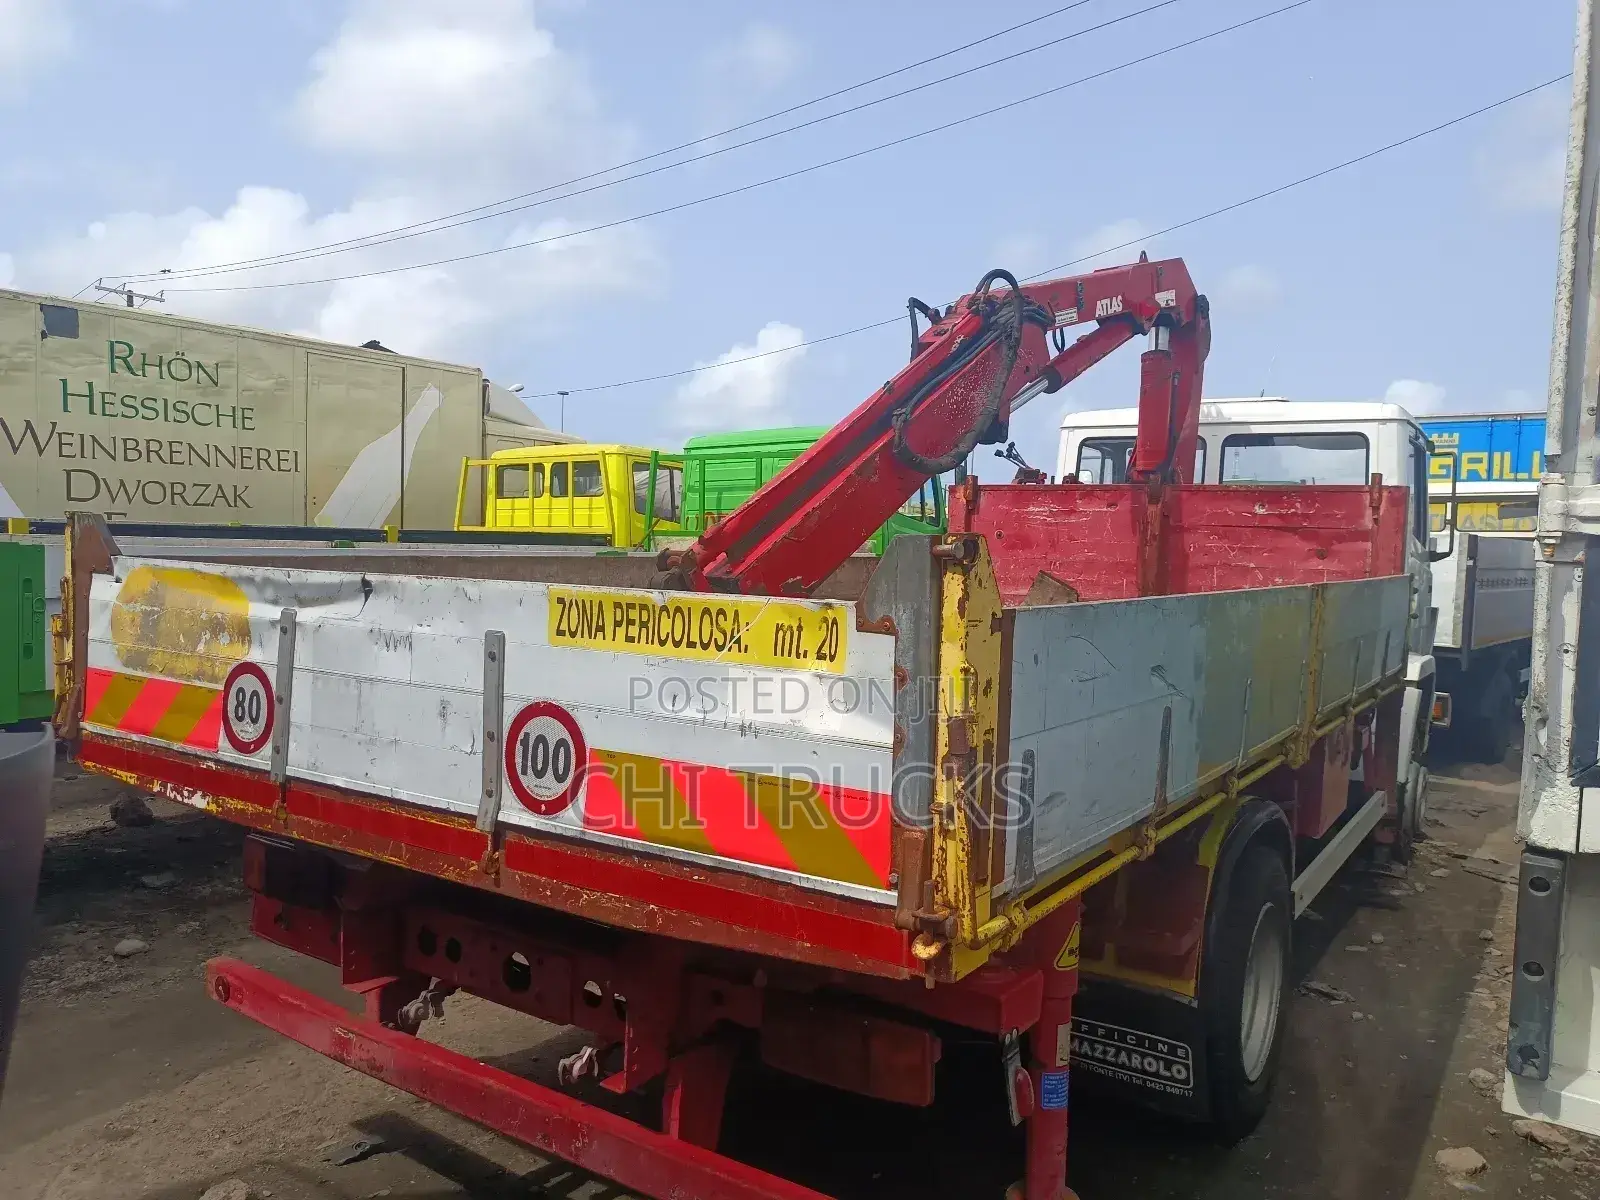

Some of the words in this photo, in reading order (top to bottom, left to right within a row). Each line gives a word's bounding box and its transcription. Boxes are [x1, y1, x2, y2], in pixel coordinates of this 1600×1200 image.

[1095, 295, 1123, 318] ATLAS
[107, 339, 221, 387] RHÖN
[59, 378, 256, 431] HESSISCHE
[0, 417, 300, 473] WEINBRENNEREI
[62, 468, 253, 509] DWORZAK
[555, 597, 606, 642] ZONA
[773, 617, 808, 659] mt.
[816, 616, 839, 663] 20
[235, 687, 262, 725] 80
[520, 732, 572, 784] 100
[1080, 1024, 1187, 1058] FFICINE
